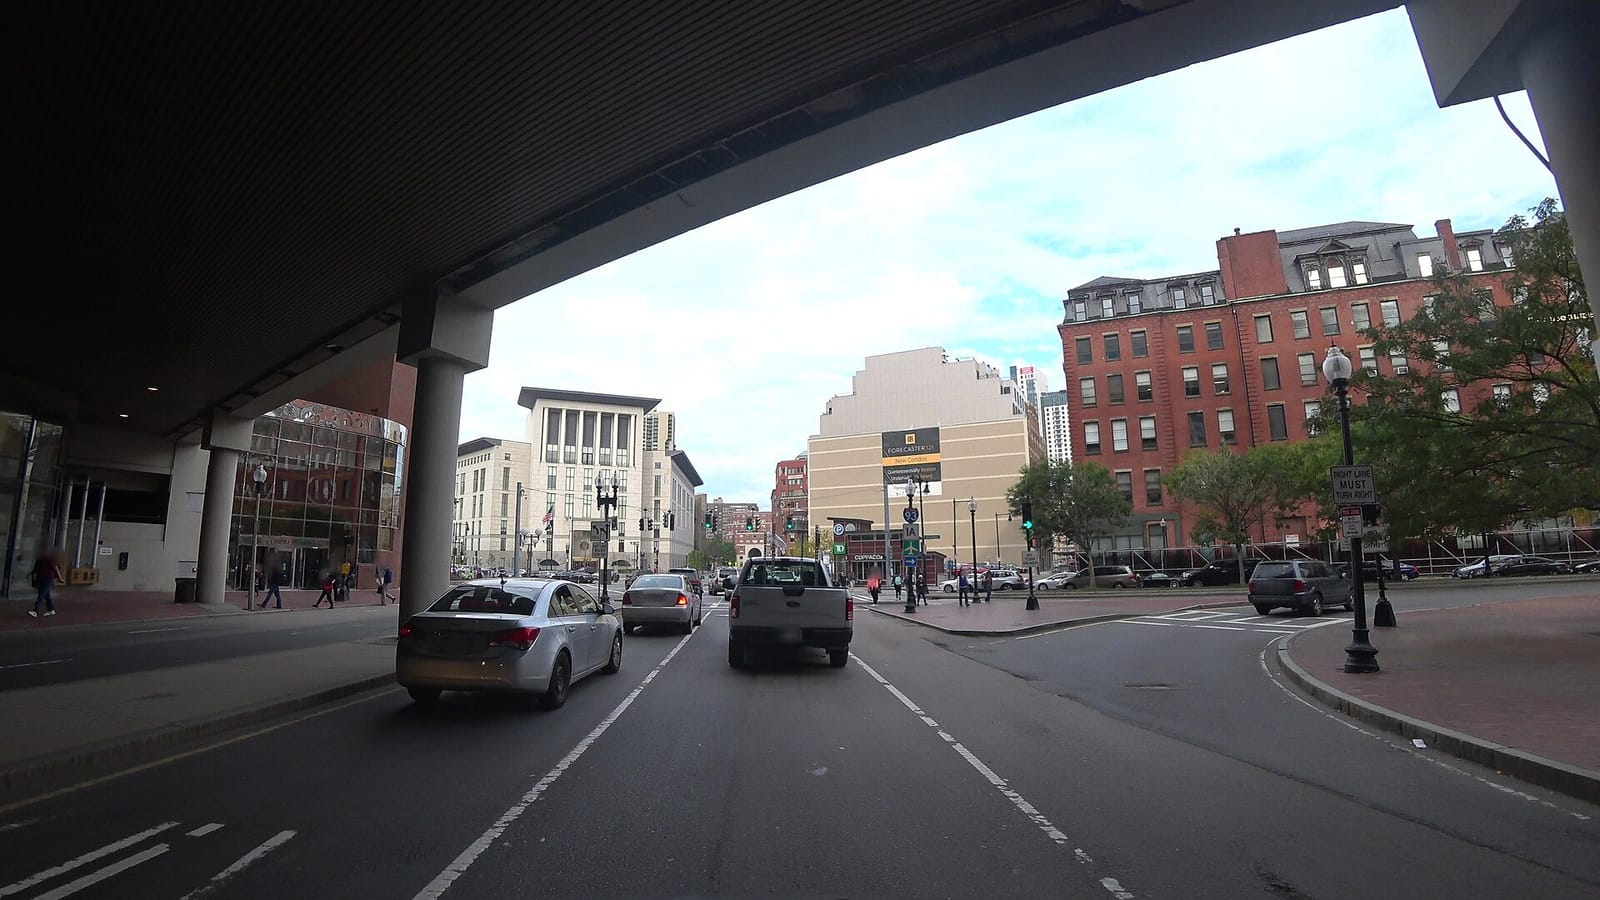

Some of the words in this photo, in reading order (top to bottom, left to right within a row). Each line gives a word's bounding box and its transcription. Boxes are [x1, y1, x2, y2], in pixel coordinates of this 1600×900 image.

[887, 445, 925, 454] FORECASTER
[1333, 470, 1352, 479] RIGHT
[1354, 469, 1371, 478] LANE
[1340, 480, 1366, 489] MUST
[1335, 491, 1353, 500] TURN
[1354, 490, 1373, 499] RIGHT
[905, 511, 917, 521] 93
[906, 527, 916, 537] 1A
[835, 544, 844, 552] TD
